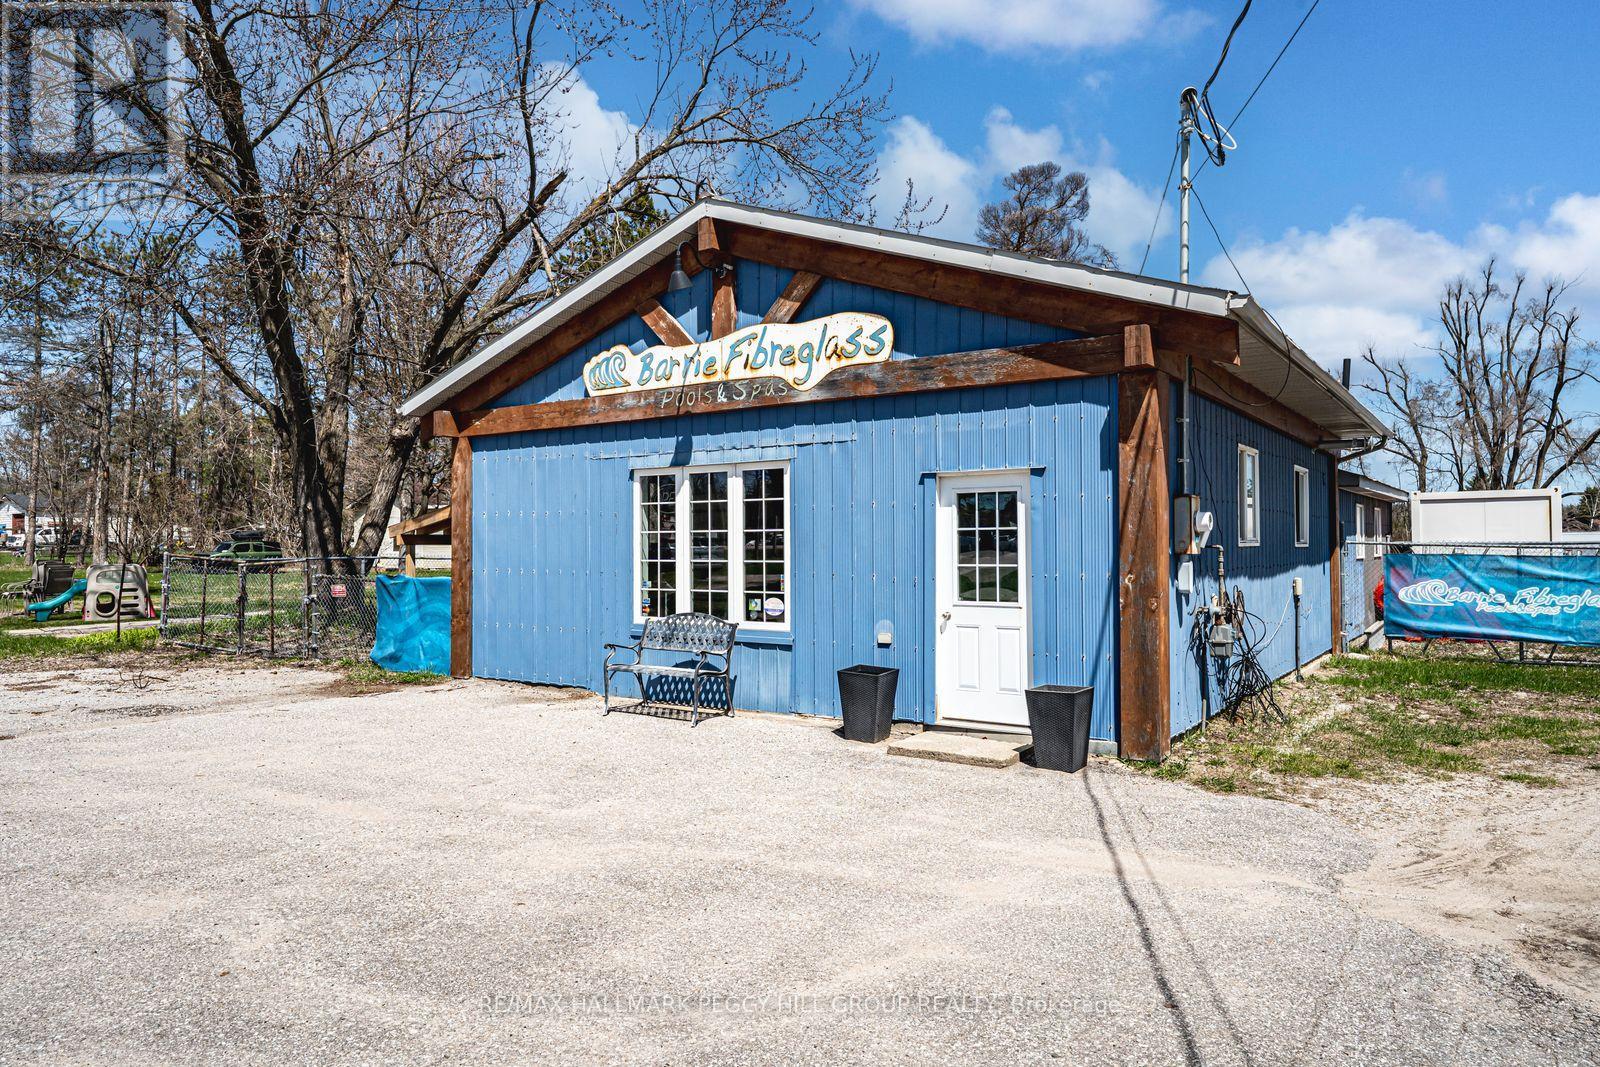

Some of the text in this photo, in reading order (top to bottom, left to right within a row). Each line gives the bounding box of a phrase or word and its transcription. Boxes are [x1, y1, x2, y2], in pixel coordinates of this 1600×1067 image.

[637, 324, 889, 386] Barrie Fibreglass
[660, 380, 788, 409] Pools & Spas
[1446, 587, 1507, 604] Barrie
